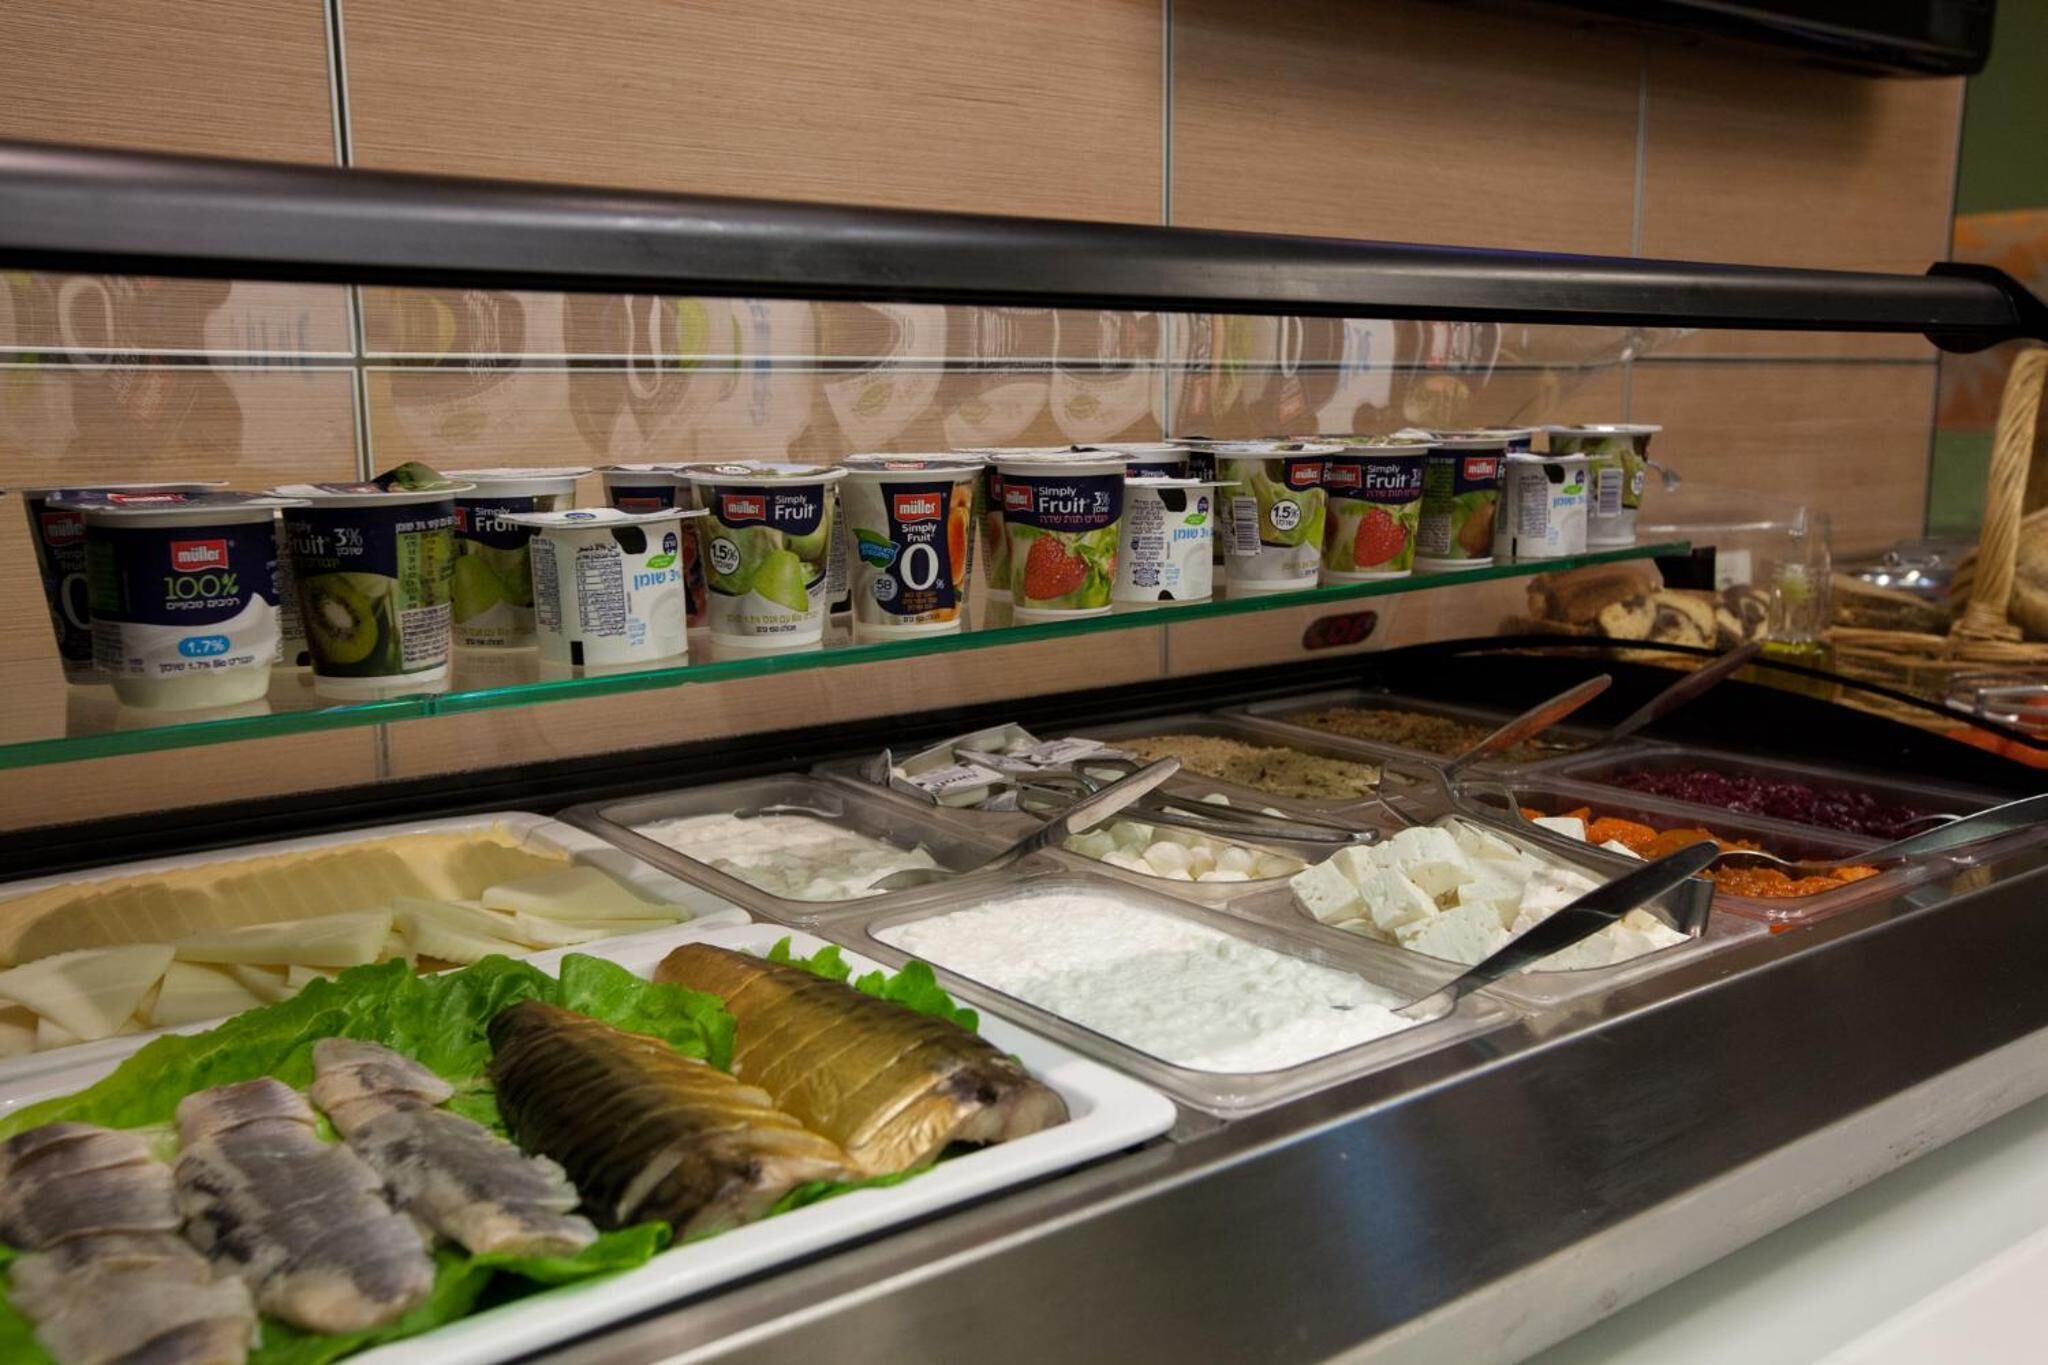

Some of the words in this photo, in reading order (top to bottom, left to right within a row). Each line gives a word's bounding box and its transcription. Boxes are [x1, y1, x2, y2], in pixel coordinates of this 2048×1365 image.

[1367, 464, 1400, 474] Simply
[1366, 474, 1406, 488] Fruit
[1039, 486, 1077, 497] Simply
[775, 495, 808, 504] Simply
[1039, 497, 1086, 513] Fruit
[775, 504, 815, 520] Fruit
[900, 500, 936, 514] müller
[901, 523, 937, 534] Simply
[333, 528, 364, 545] 3%
[907, 533, 932, 542] Fruit
[178, 546, 220, 563] müller
[163, 573, 240, 600] 100%
[634, 572, 666, 591] שומן
[876, 578, 893, 591] 58
[187, 638, 225, 653] 1.7%
